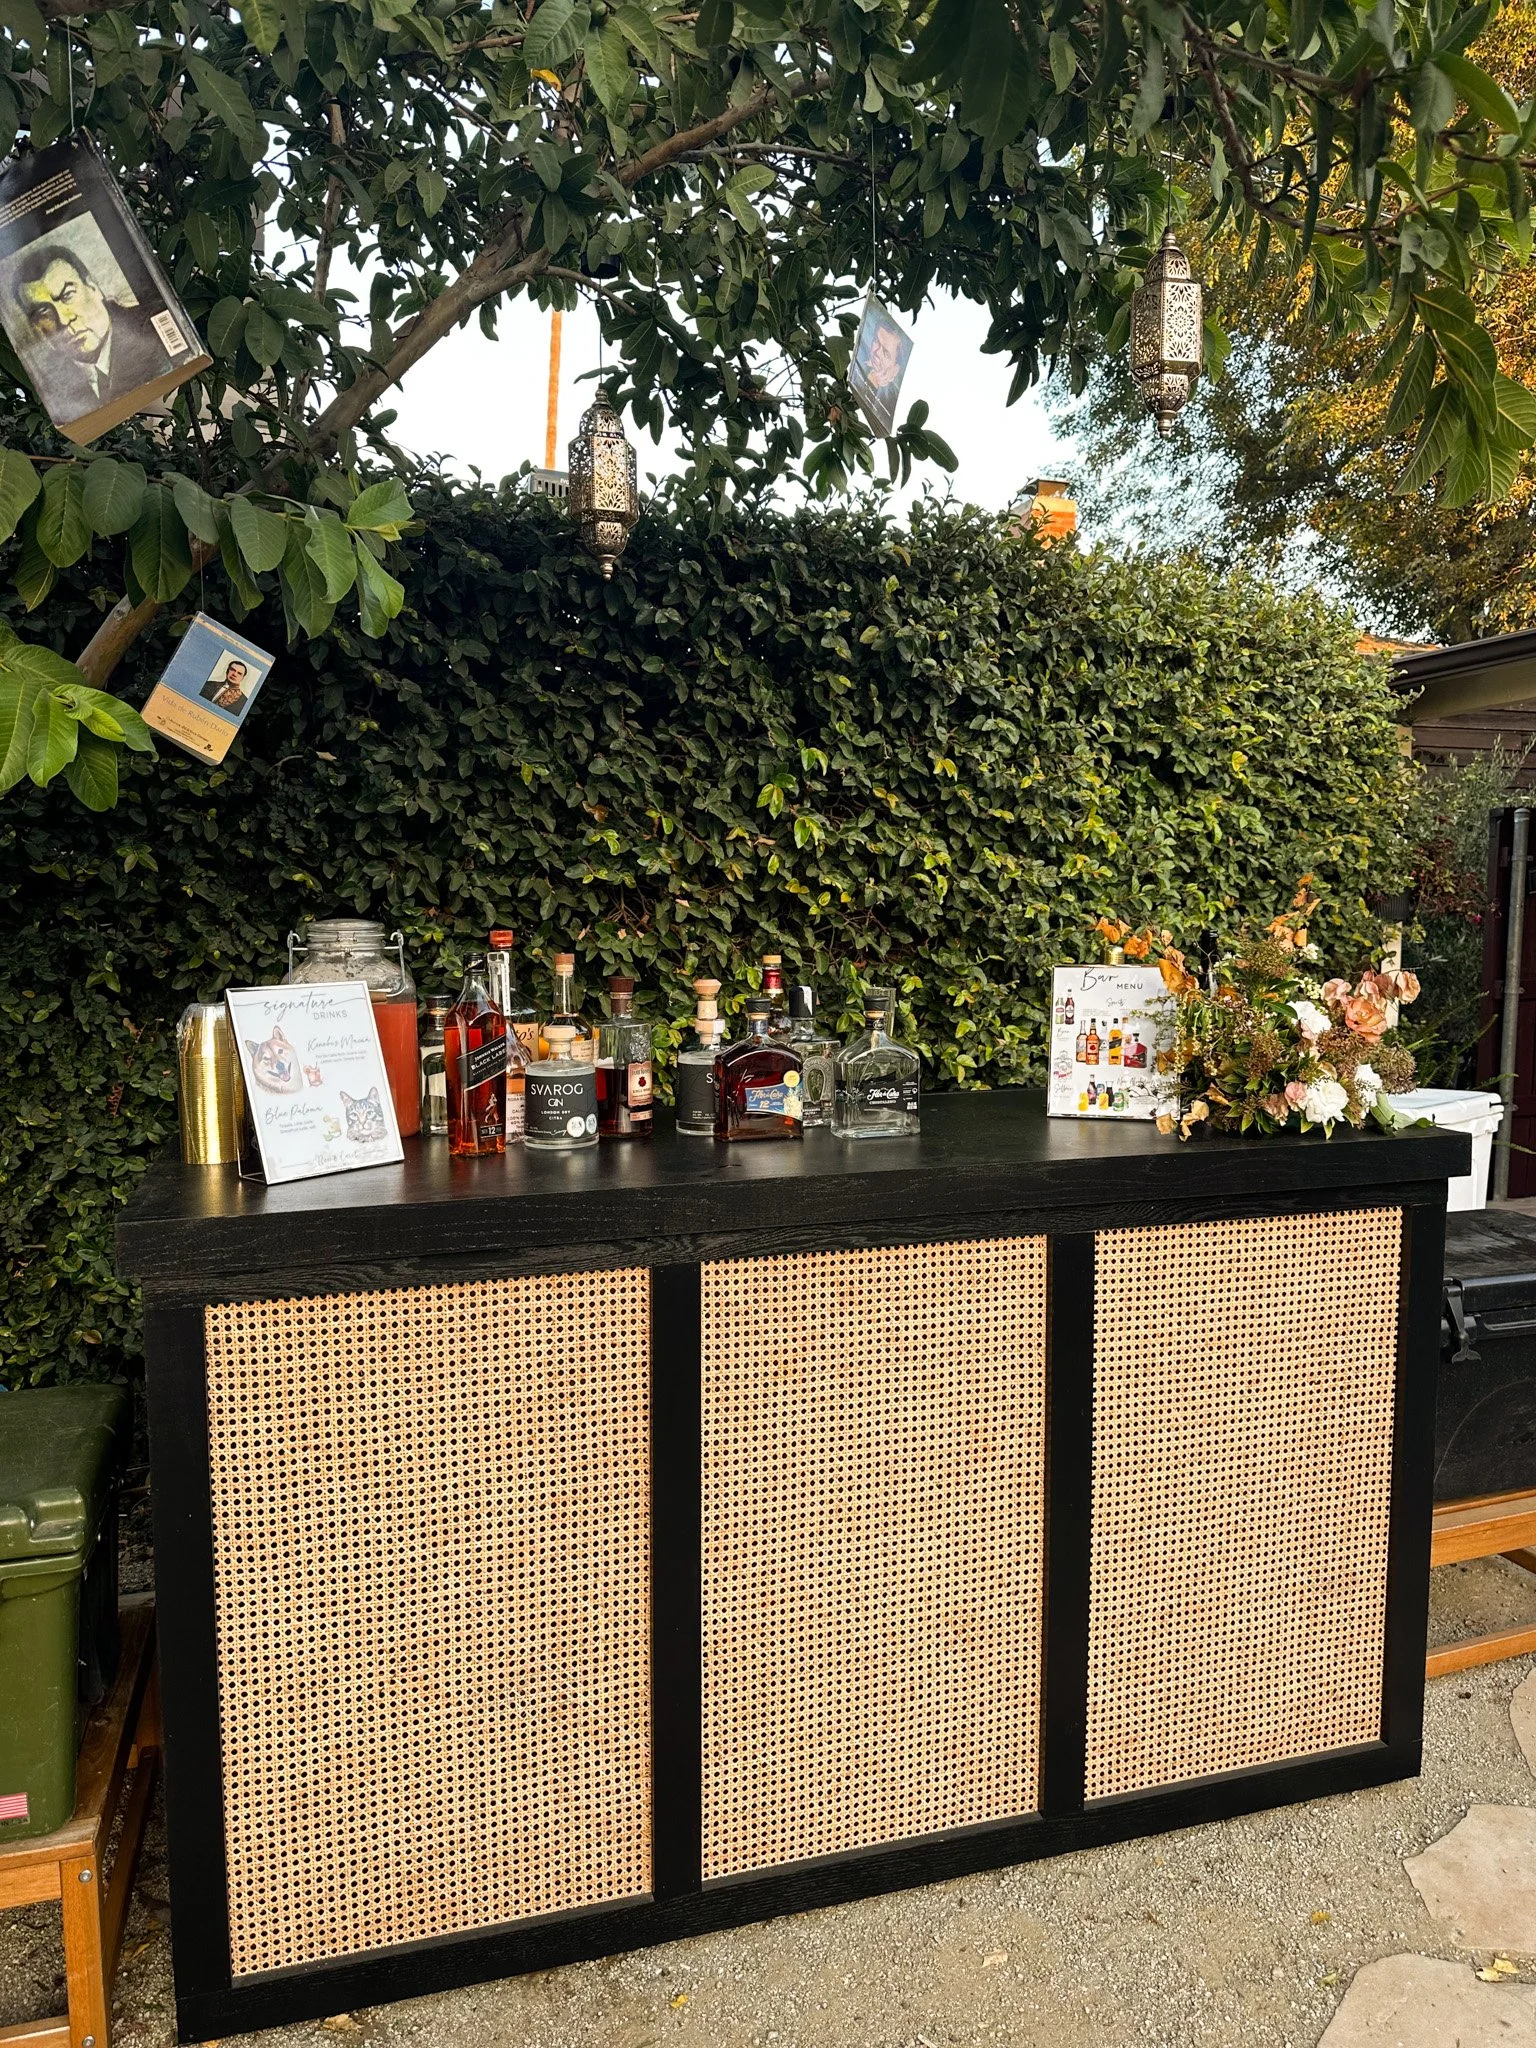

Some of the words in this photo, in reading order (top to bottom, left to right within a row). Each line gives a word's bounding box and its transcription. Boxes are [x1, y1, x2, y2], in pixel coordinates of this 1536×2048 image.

[161, 694, 177, 706] Vida
[178, 703, 187, 713] de
[1080, 967, 1119, 991] Bar
[263, 991, 335, 1022] signature
[313, 1009, 348, 1021] DRINKS
[471, 1056, 491, 1070] BLACK
[530, 1083, 584, 1096] SVAROG
[547, 1098, 564, 1107] GIN
[759, 1100, 770, 1109] 12
[265, 1104, 288, 1125] Blue
[289, 1103, 324, 1121] Paloma
[488, 1126, 496, 1134] 12
